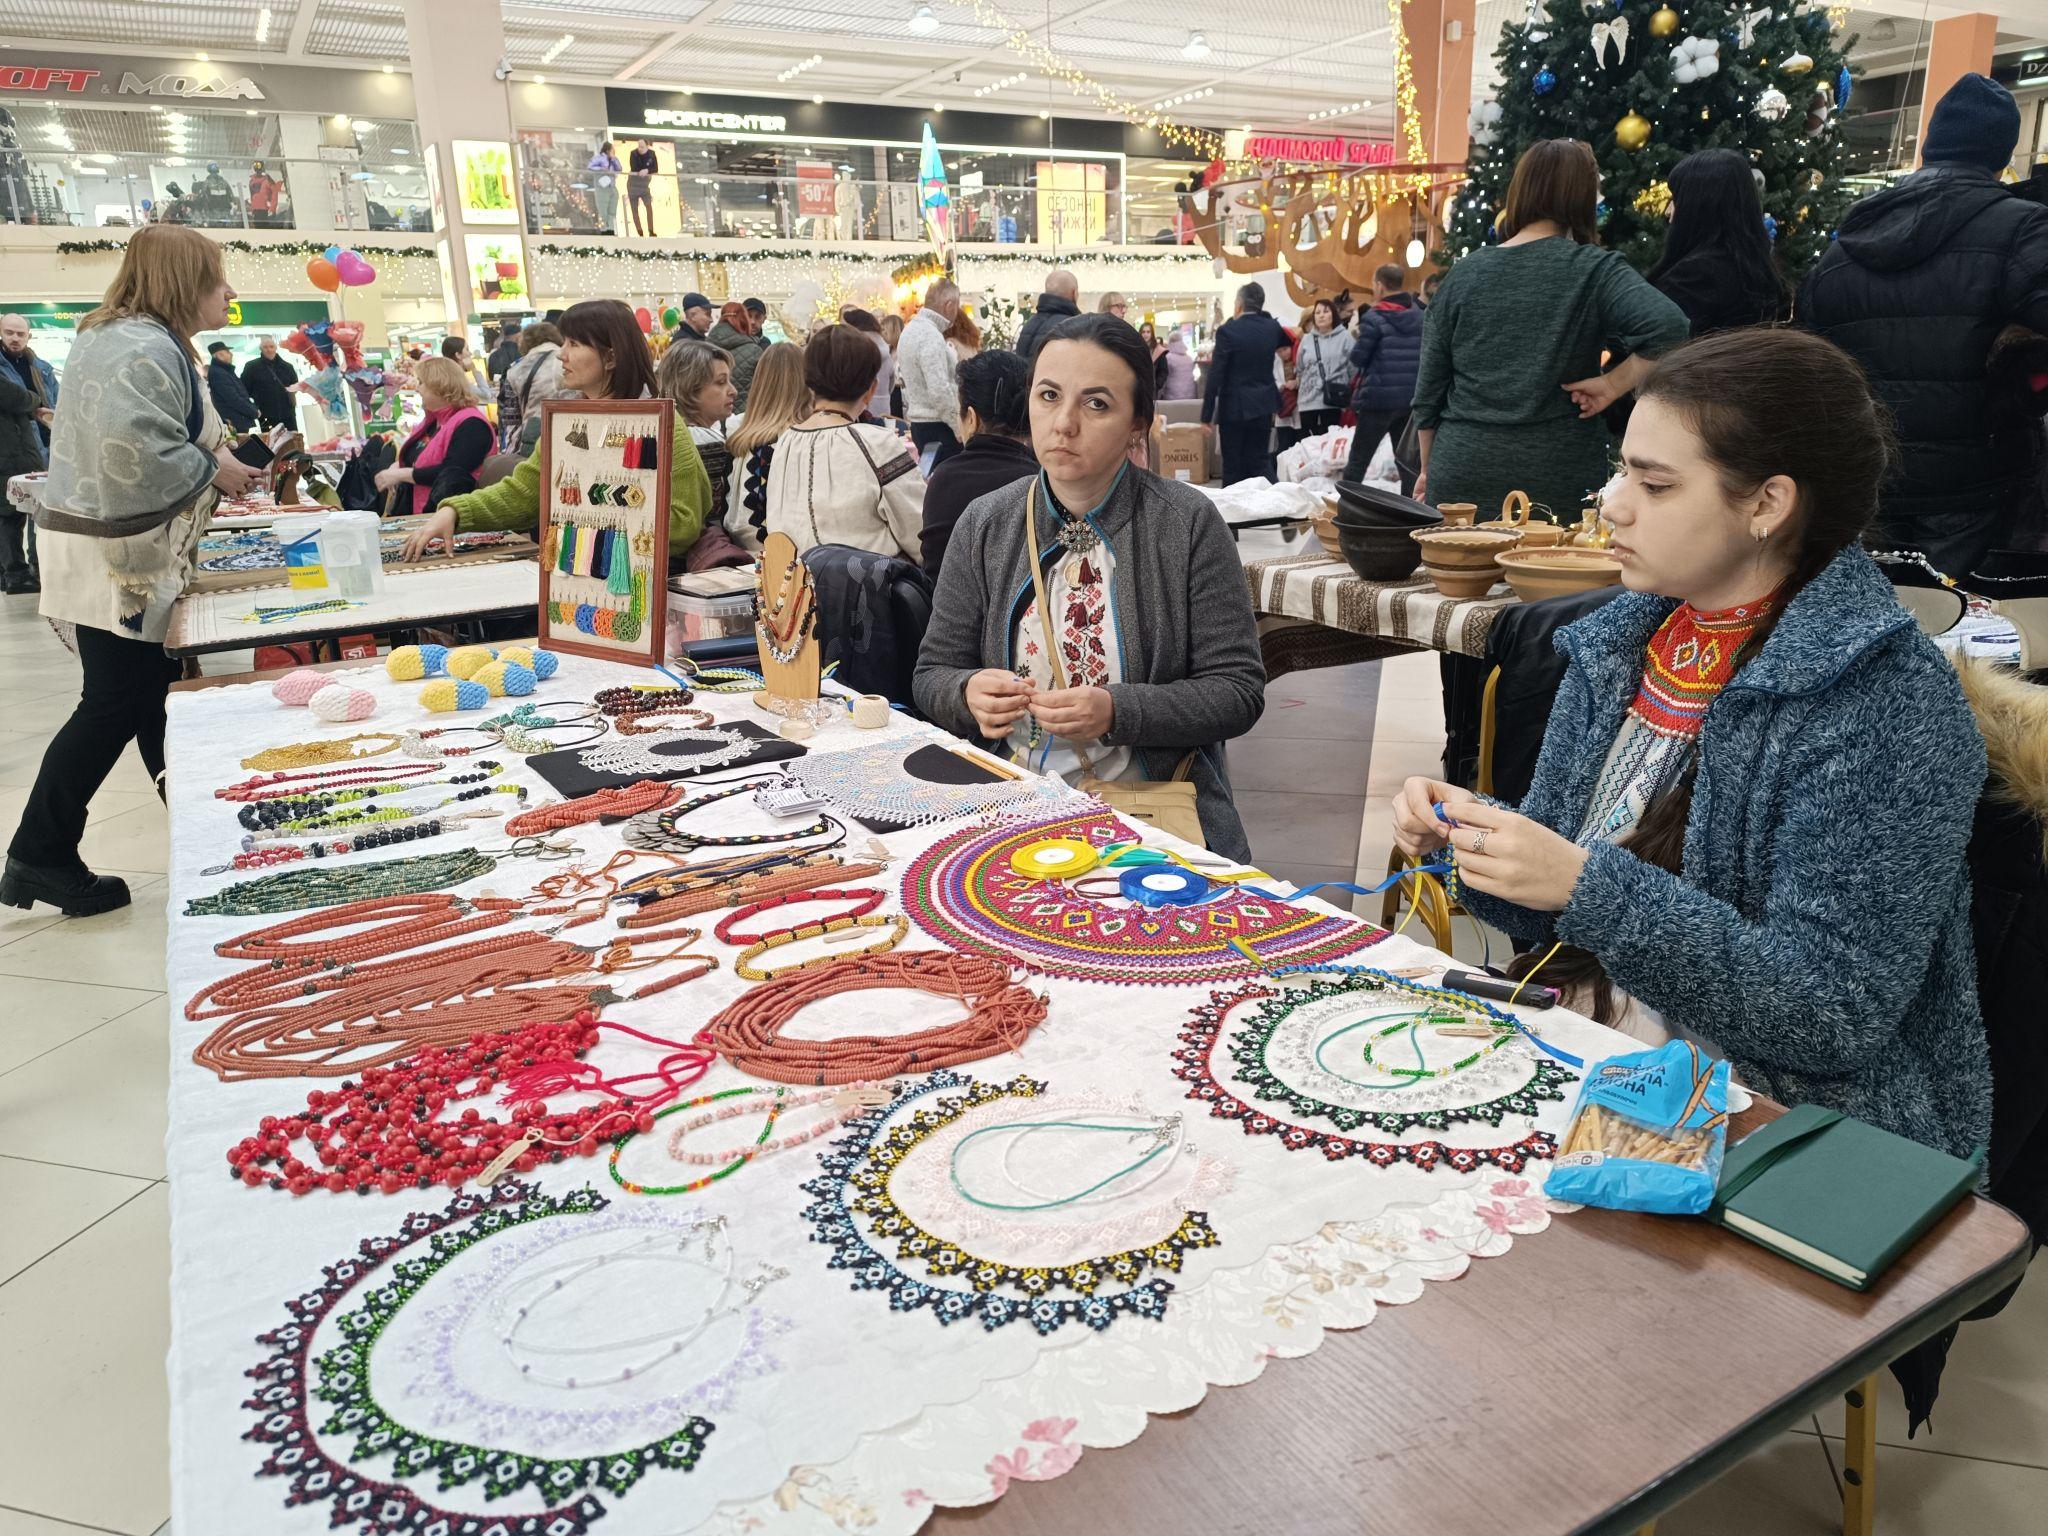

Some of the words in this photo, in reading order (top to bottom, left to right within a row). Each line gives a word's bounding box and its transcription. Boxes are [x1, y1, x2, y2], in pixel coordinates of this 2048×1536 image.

[0, 65, 100, 93] ОРТ
[644, 108, 787, 132] SPORTCENTER
[801, 183, 832, 202] -50%
[1164, 453, 1199, 463] STRONG
